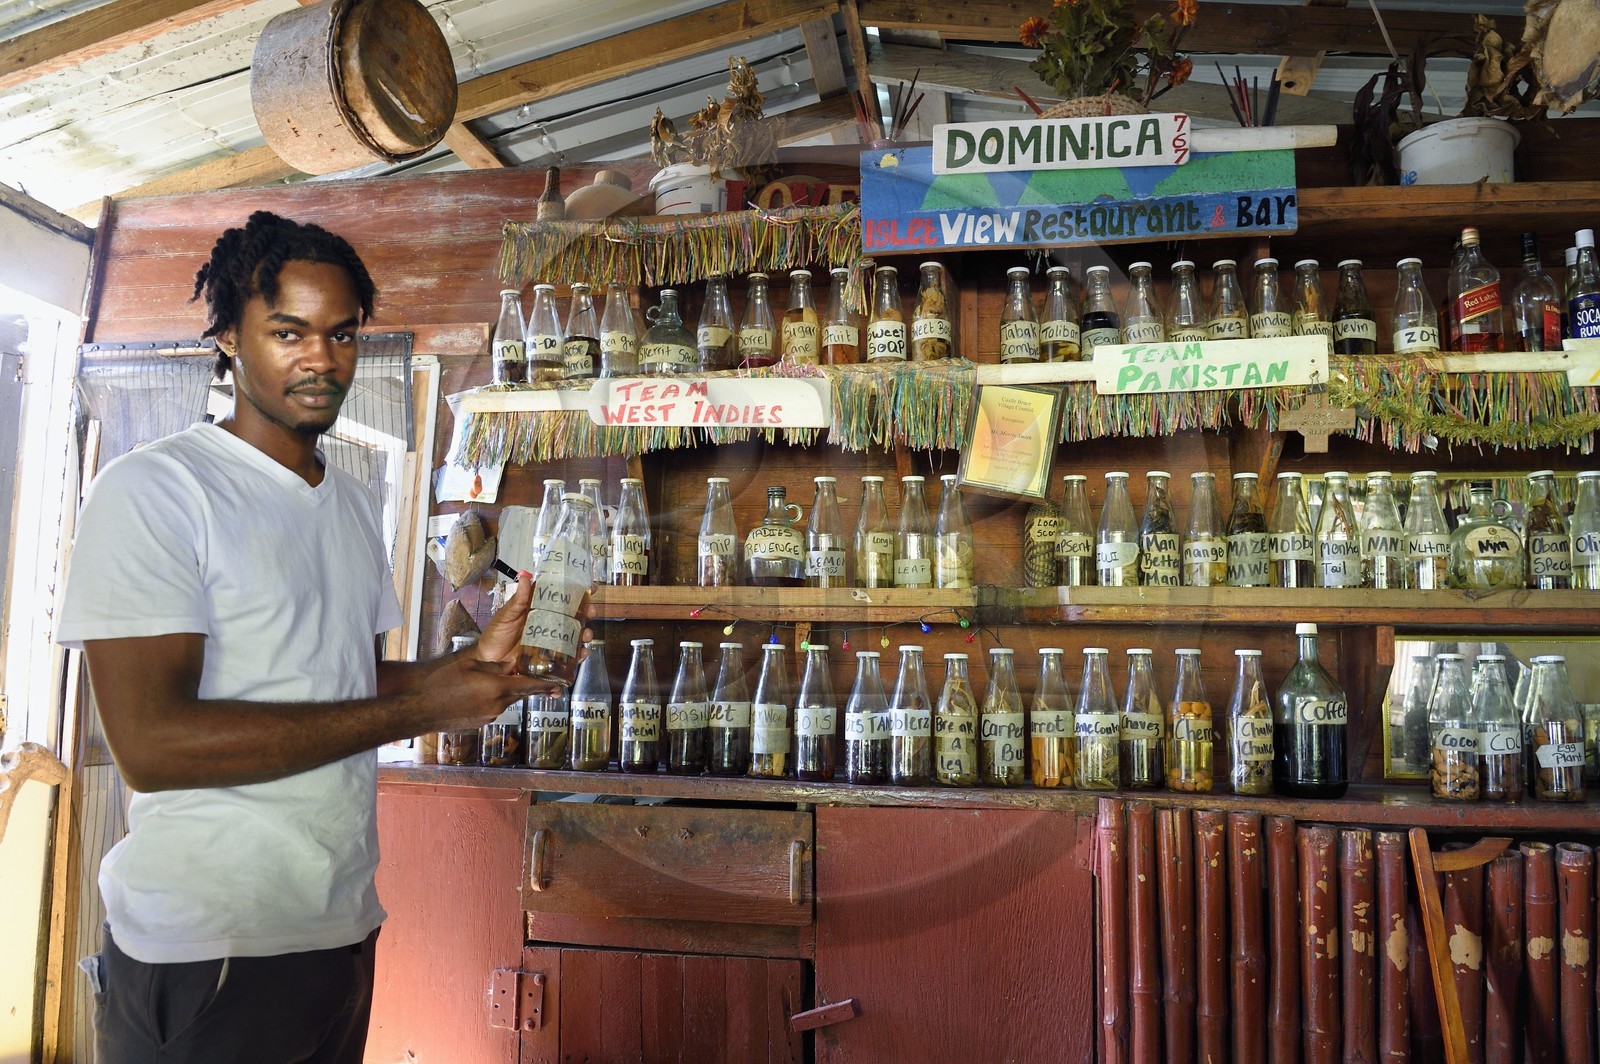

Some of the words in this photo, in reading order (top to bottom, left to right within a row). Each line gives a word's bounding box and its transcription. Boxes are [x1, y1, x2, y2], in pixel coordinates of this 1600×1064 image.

[945, 118, 1163, 168] DOMINICA
[1211, 203, 1226, 227] &
[1236, 194, 1297, 227] Bar
[1577, 308, 1600, 326] SOCA
[1122, 324, 1162, 342] Trump
[1580, 325, 1600, 338] RUM
[1122, 343, 1203, 364] TEAM
[1116, 361, 1289, 392] PAKISTAN
[616, 381, 708, 402] TEAM
[600, 403, 671, 424] WEST
[693, 401, 784, 425] INDIES
